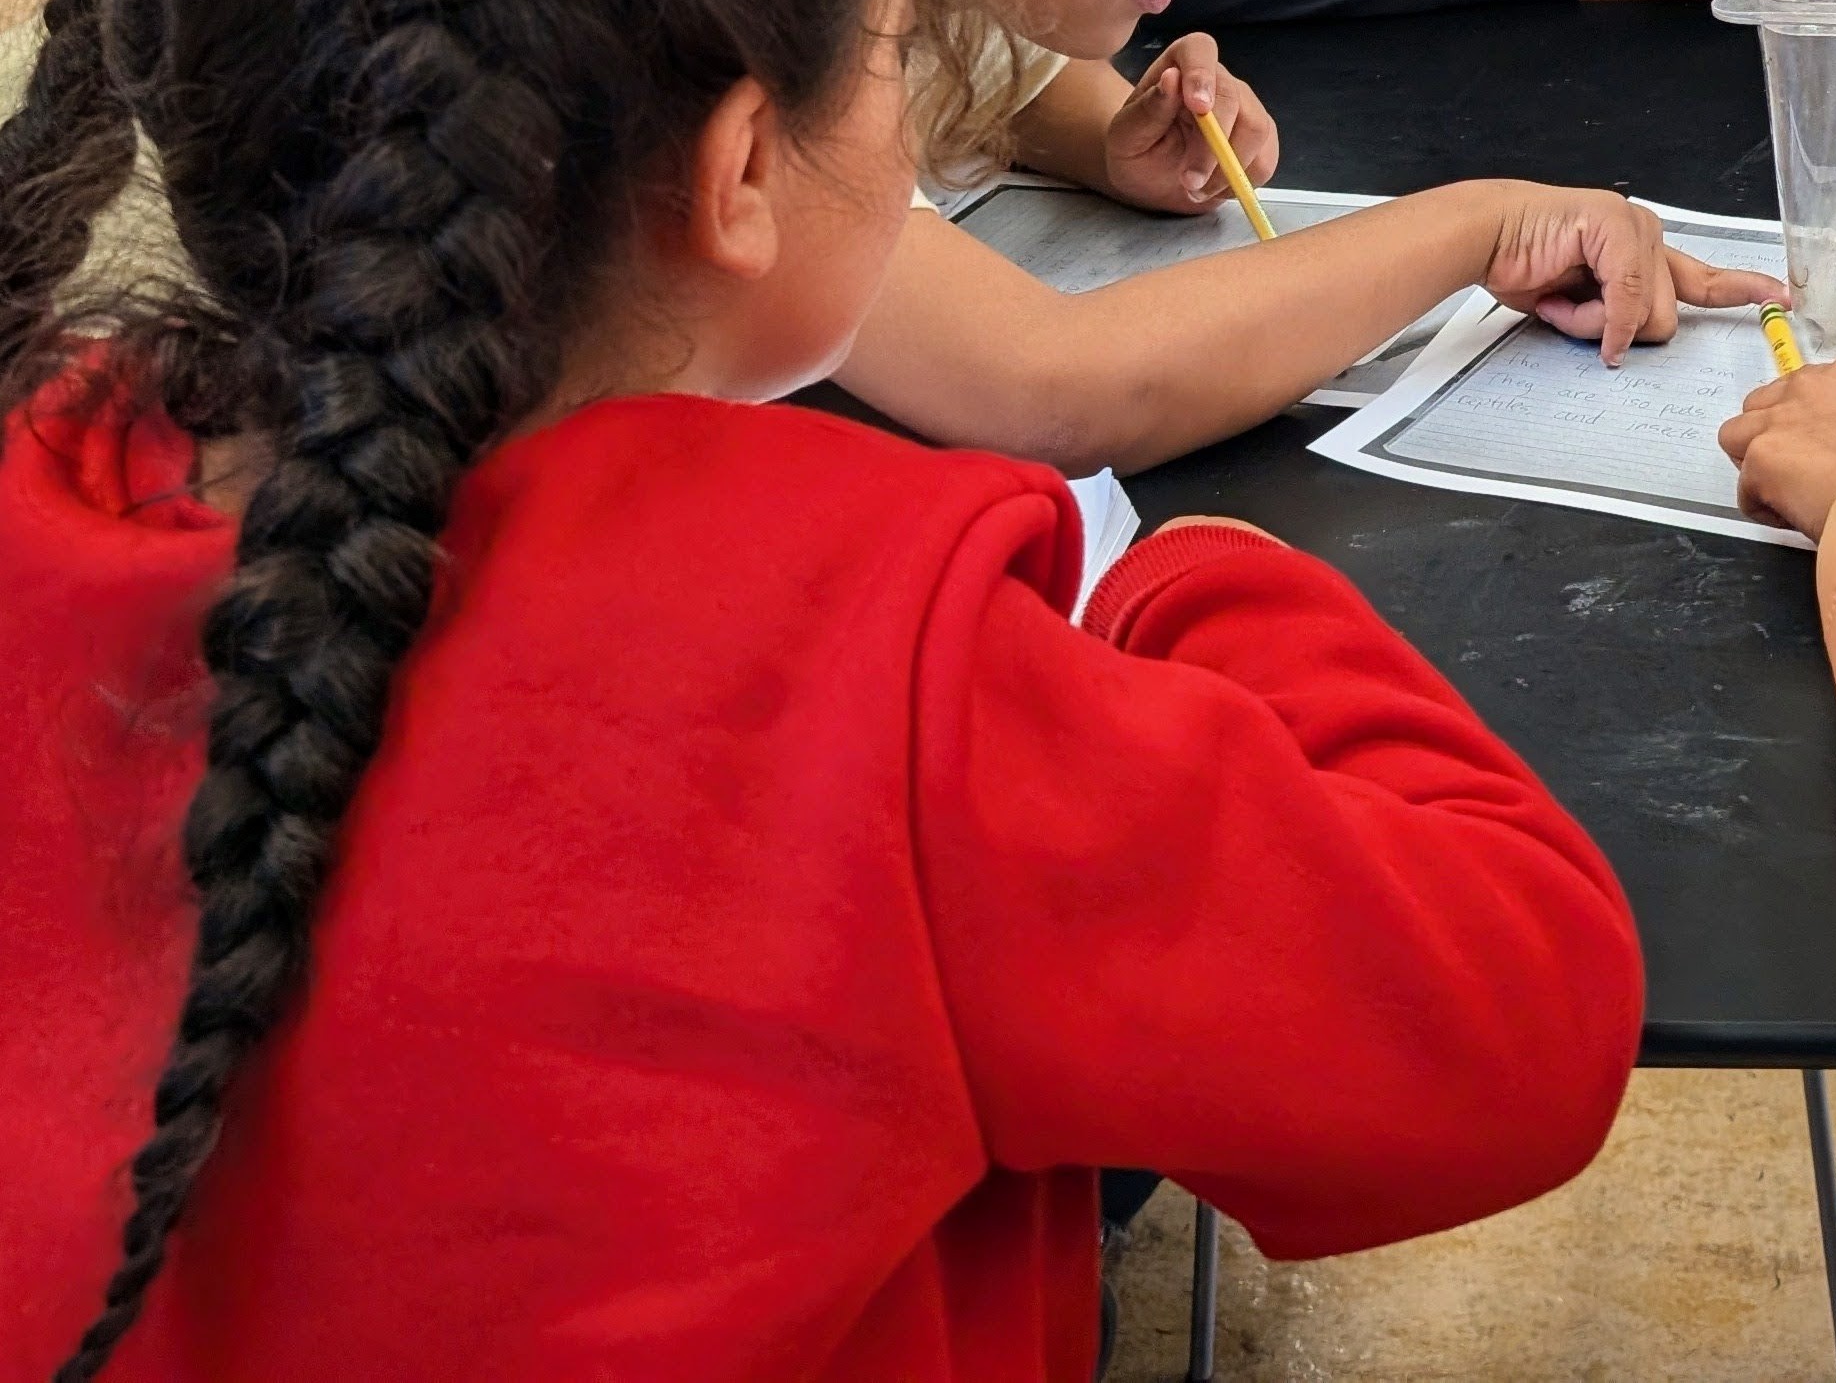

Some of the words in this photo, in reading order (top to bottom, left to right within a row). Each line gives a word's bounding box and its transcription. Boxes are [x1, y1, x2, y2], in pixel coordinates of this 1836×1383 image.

[1575, 363, 1593, 378] 4
[1557, 389, 1598, 401] are
[1553, 409, 1607, 426] and
